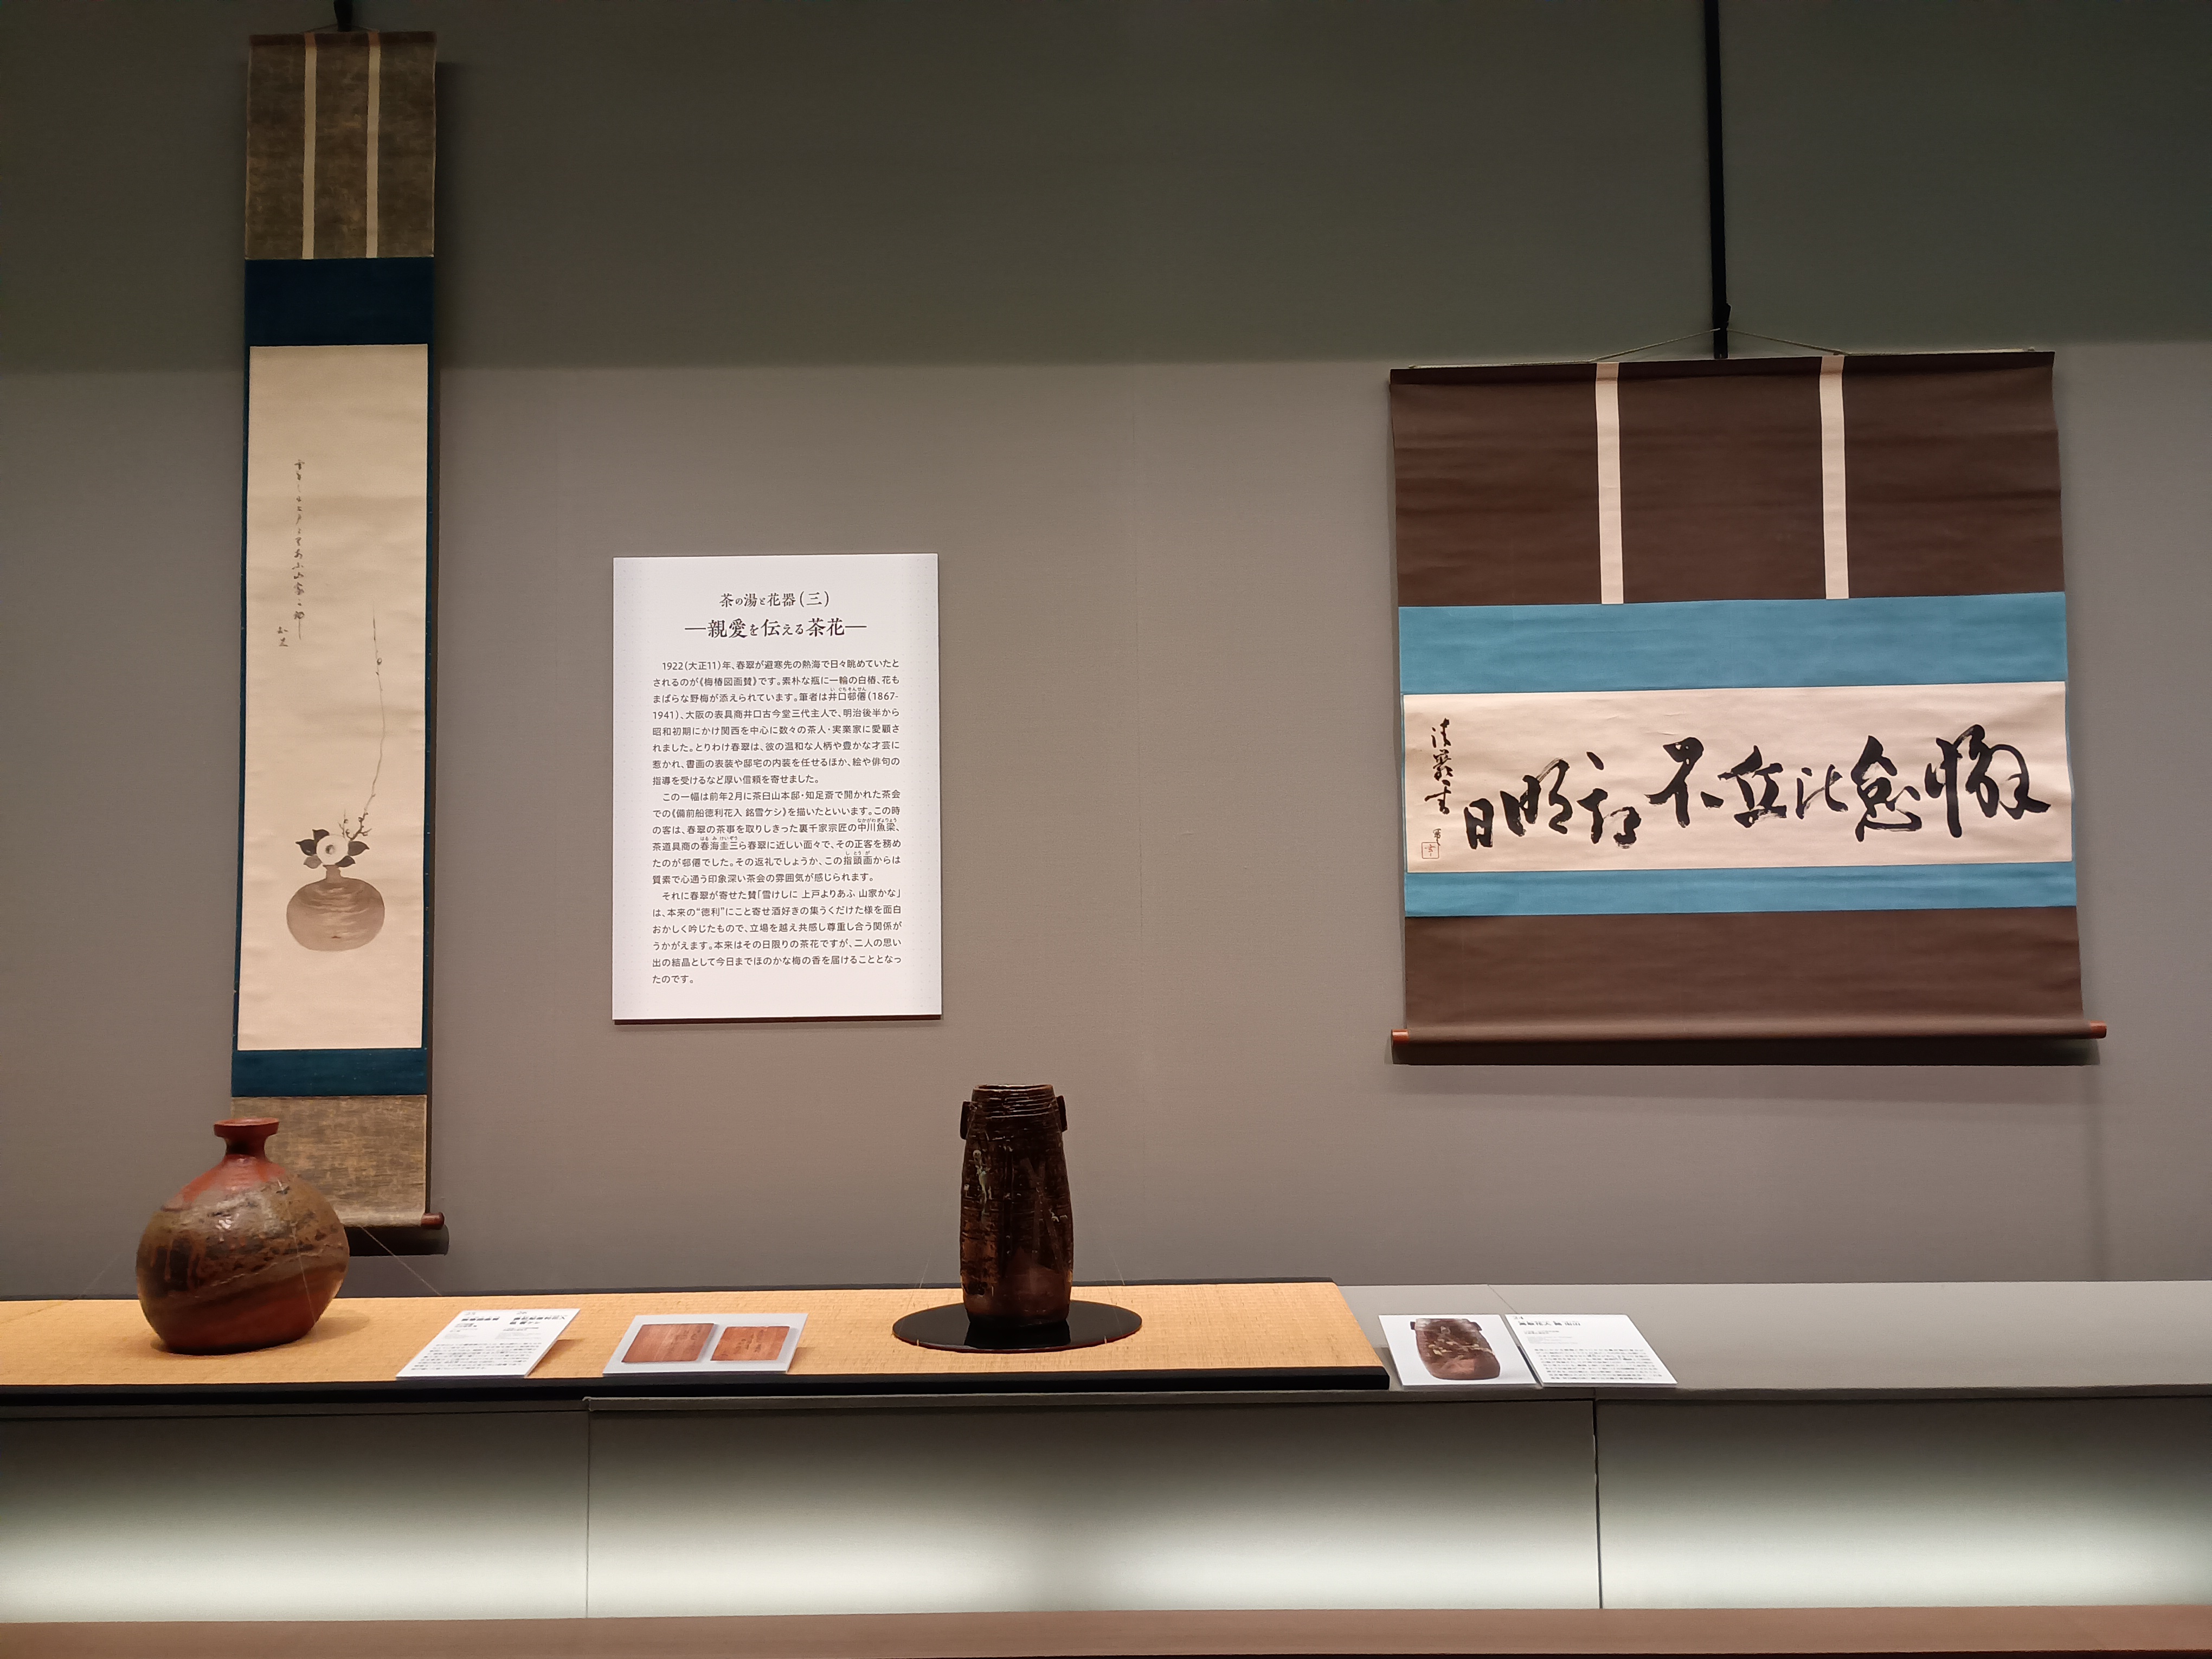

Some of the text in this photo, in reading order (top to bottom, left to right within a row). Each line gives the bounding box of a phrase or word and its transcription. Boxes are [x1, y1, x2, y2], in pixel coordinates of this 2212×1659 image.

[719, 590, 829, 608] 茶の湯と花器(三)
[652, 774, 819, 786] 指導を受けるなど厚い信頼を寄せました。
[652, 872, 873, 885] 質素で心通う印象深い茶会の雰囲気が感じられます。
[801, 889, 856, 899] 上戸よりあふ
[859, 888, 901, 898] 山家かな」
[652, 974, 693, 984] たのです。
